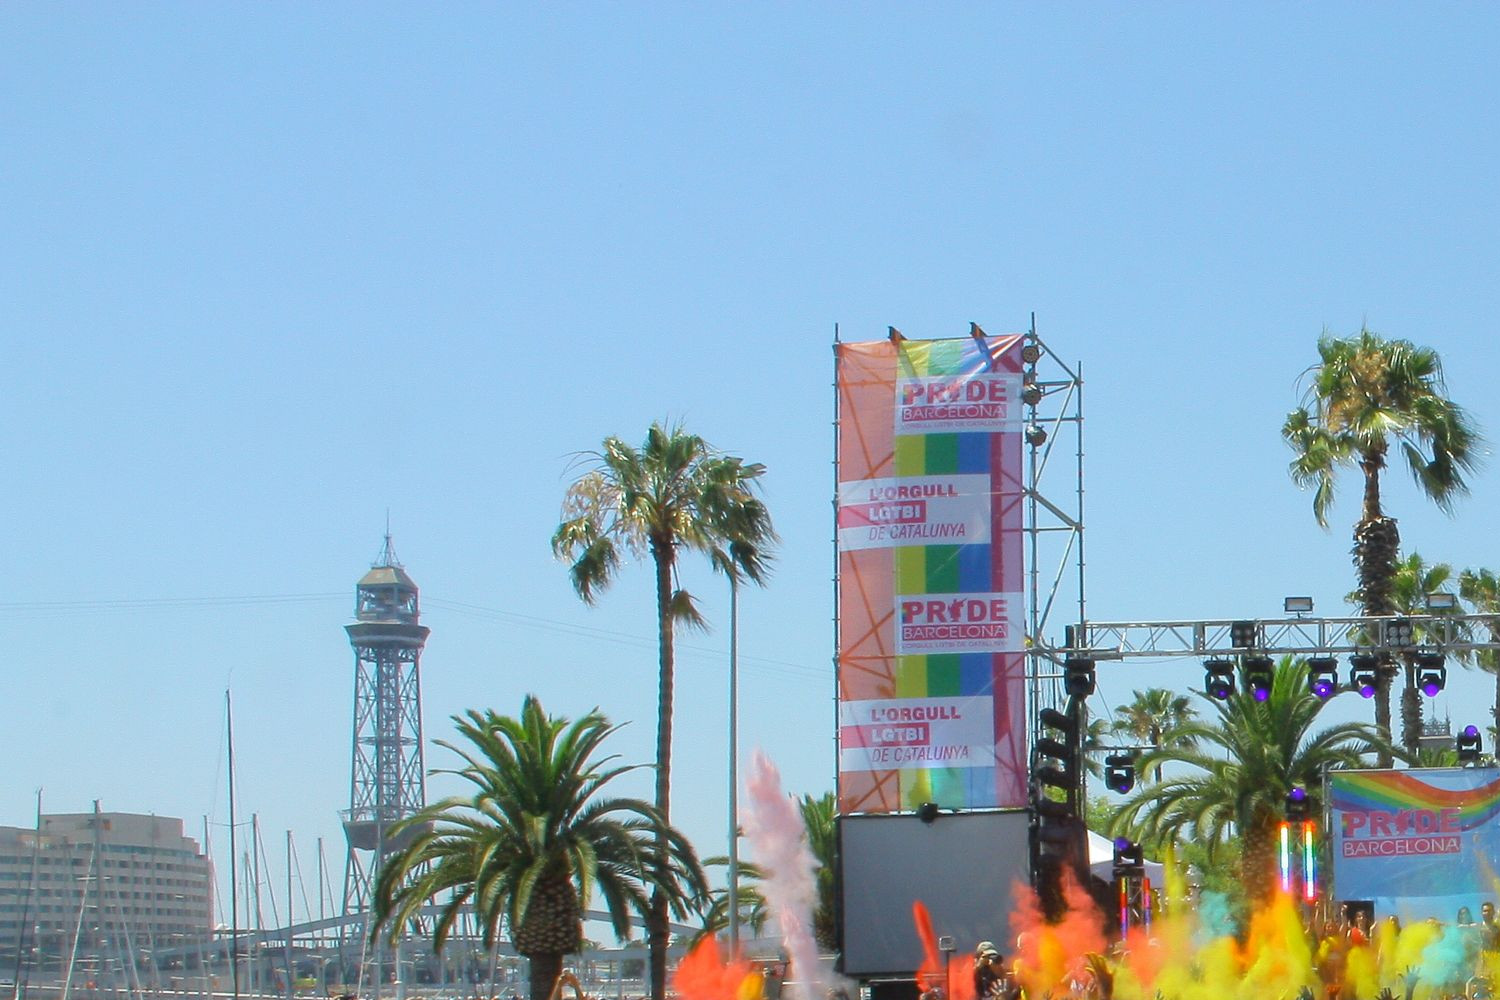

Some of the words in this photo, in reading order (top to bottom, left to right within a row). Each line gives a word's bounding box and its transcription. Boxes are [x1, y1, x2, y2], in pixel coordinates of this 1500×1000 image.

[903, 405, 1006, 420] BARCELONA
[870, 483, 959, 501] L'ORGULL
[869, 504, 921, 521] LGTBI
[869, 526, 885, 541] DE
[890, 522, 966, 540] CATALUNYA
[903, 625, 1007, 640] BARCELONA
[871, 705, 961, 722] L'ORGULL
[871, 726, 925, 743] LGTBI
[872, 747, 889, 763] DE
[894, 744, 969, 762] CATALUNYA
[1343, 837, 1460, 857] BARCELONA
